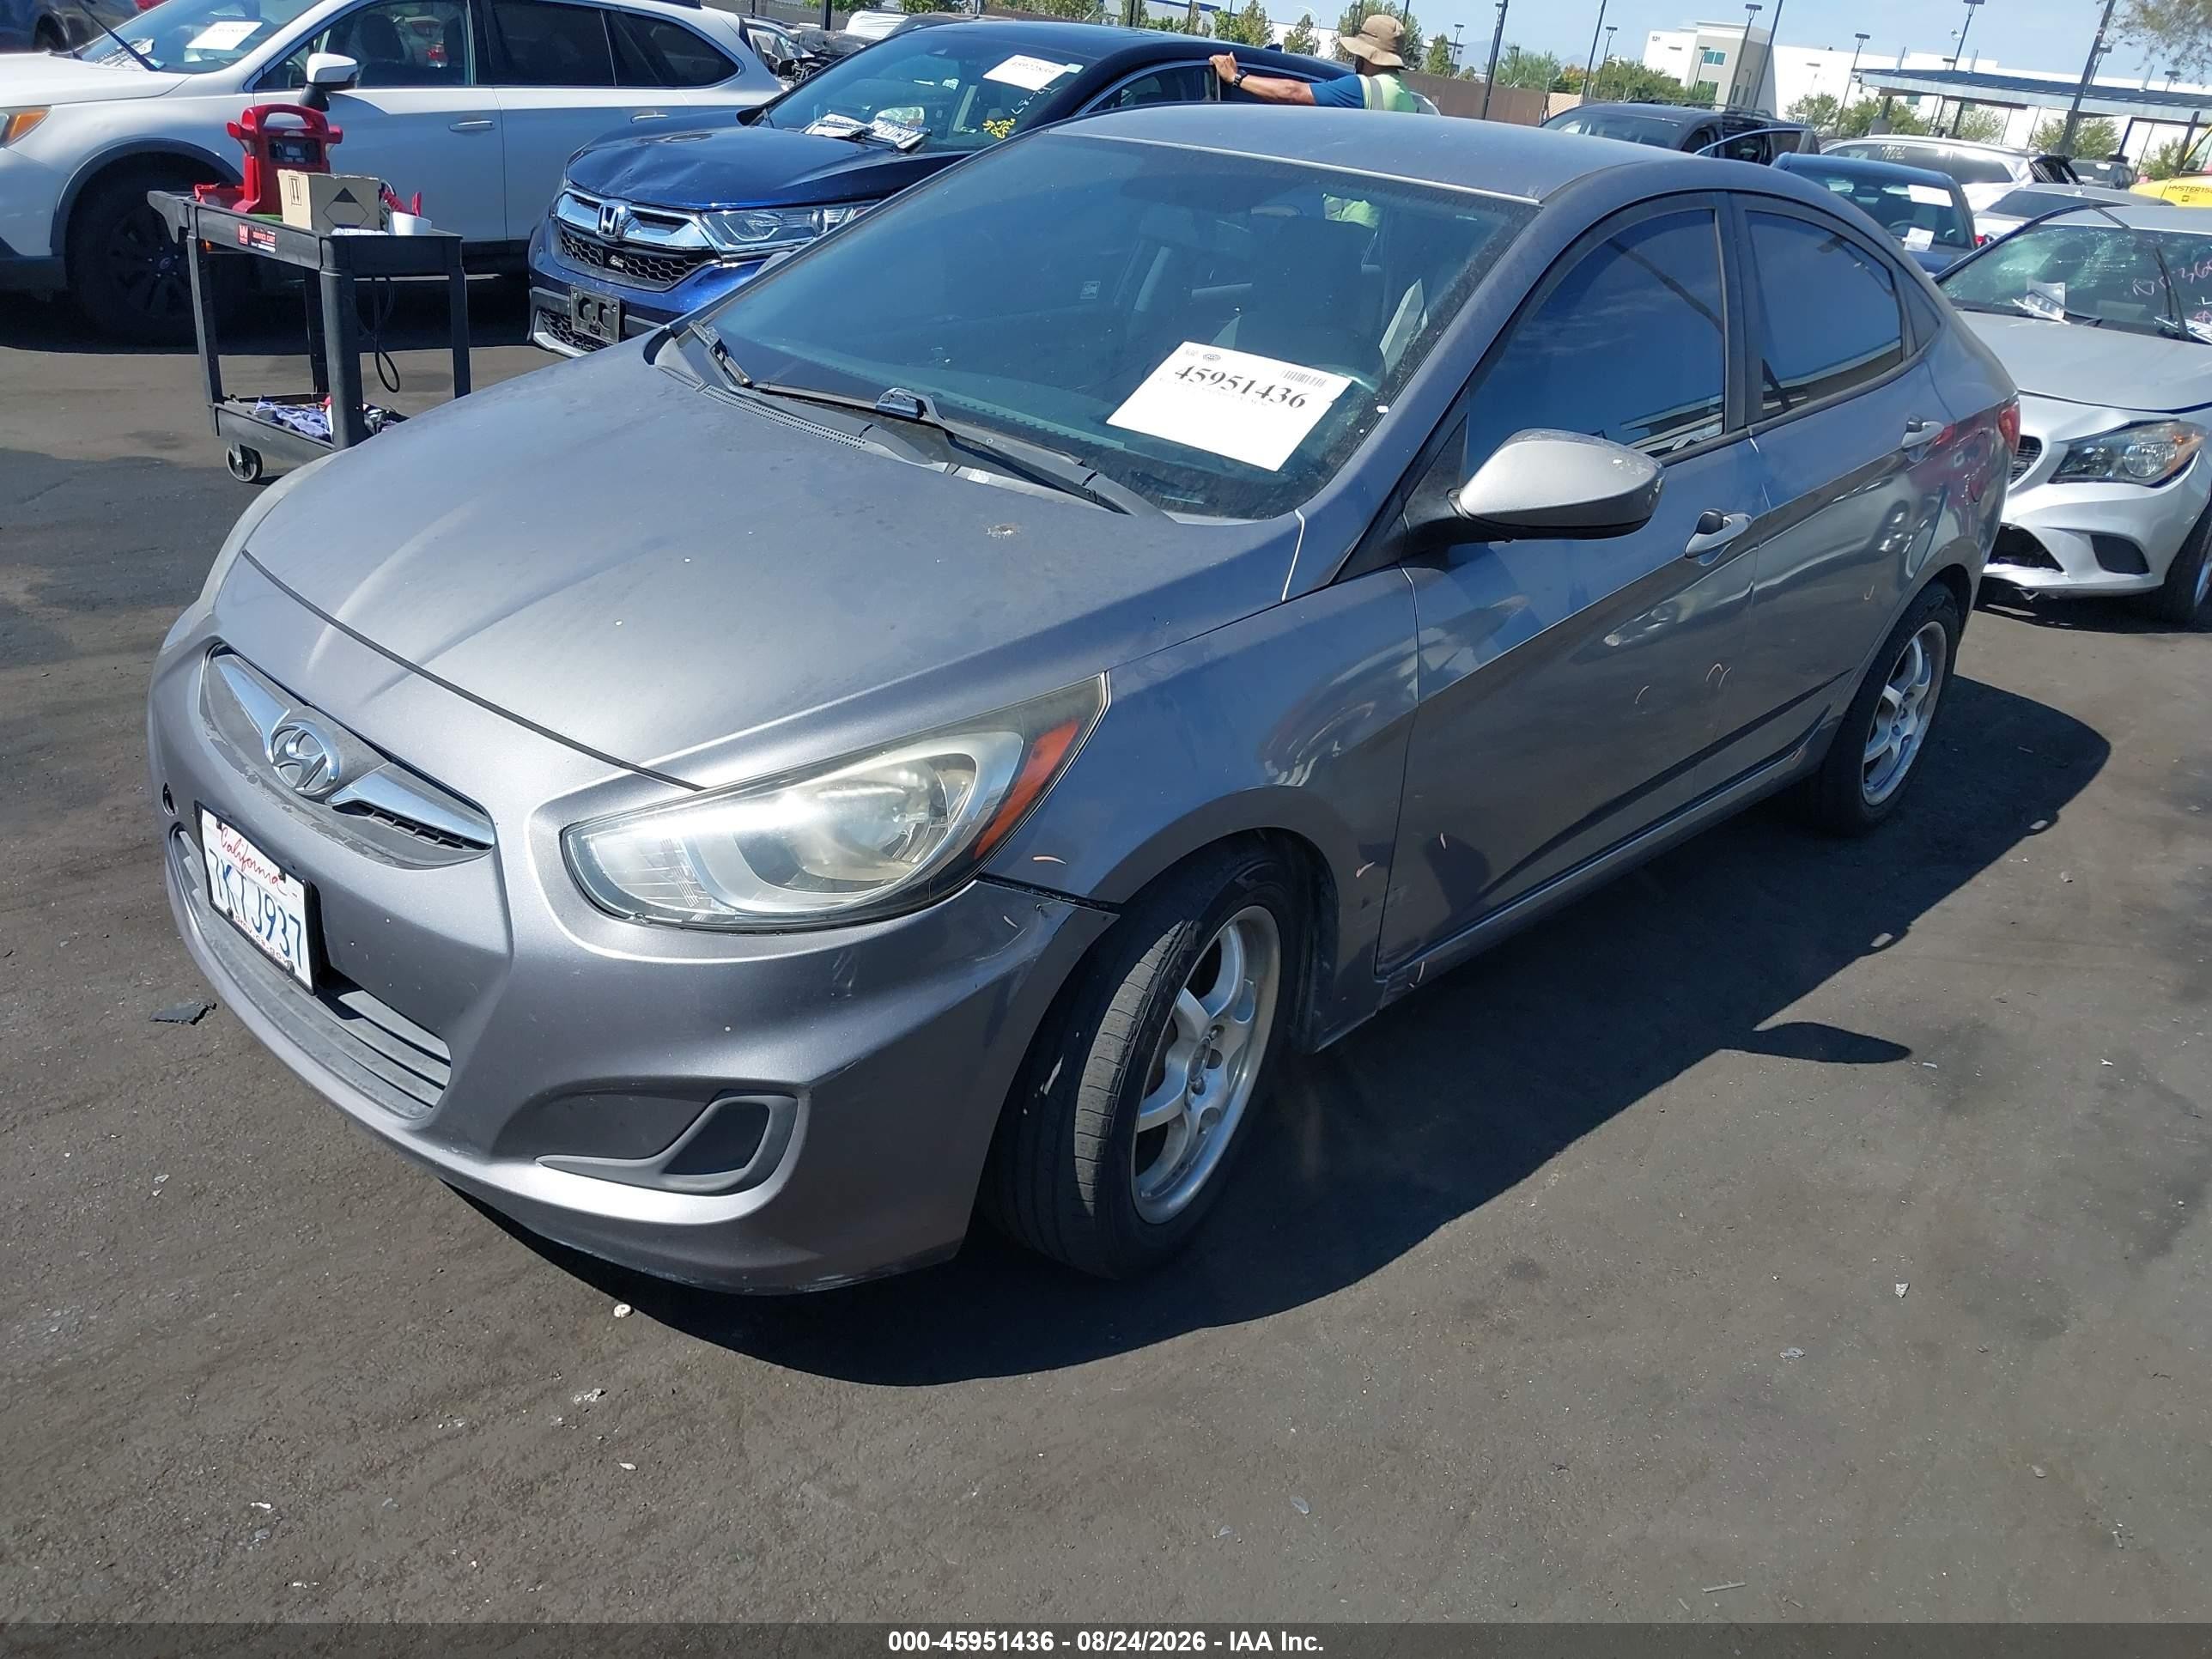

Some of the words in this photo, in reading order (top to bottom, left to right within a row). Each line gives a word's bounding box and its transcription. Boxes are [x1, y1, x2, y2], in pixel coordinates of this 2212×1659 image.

[1174, 365, 1310, 409] 45951436
[221, 826, 287, 896] California
[209, 847, 302, 969] 7KTJ937
[235, 915, 289, 965] dmv.ca.gov
